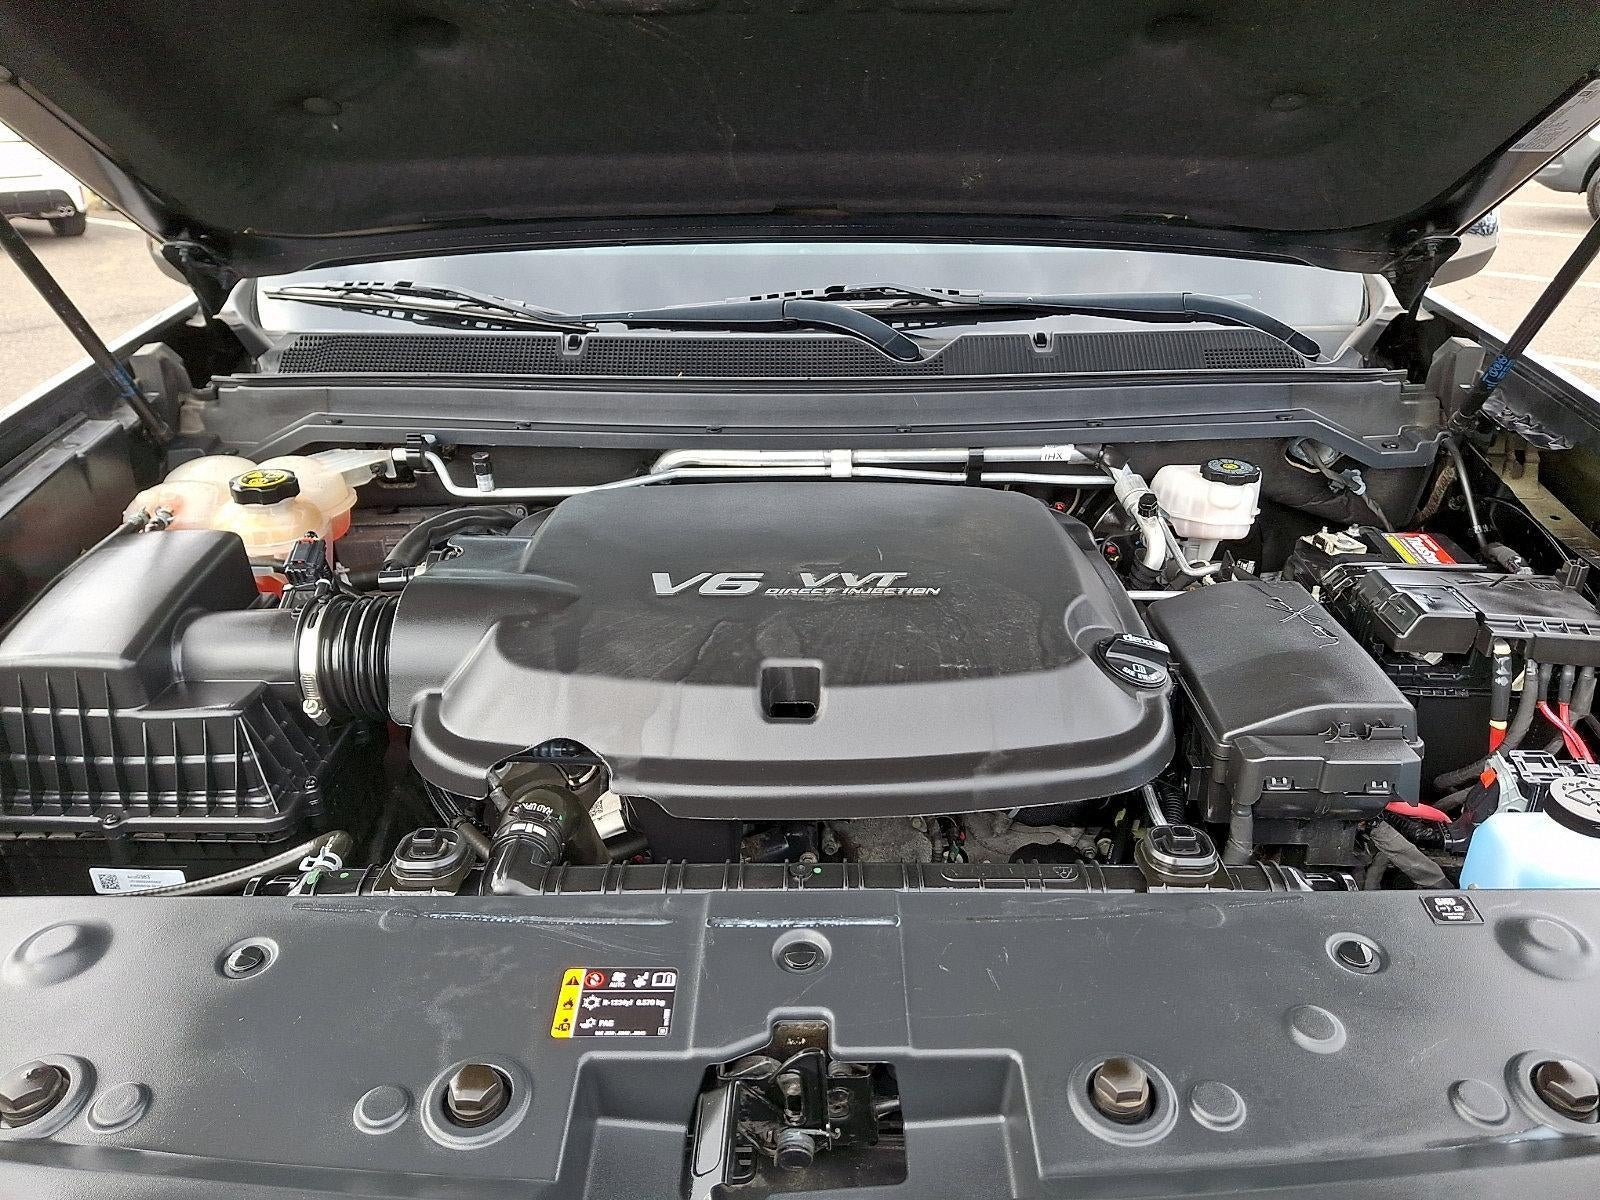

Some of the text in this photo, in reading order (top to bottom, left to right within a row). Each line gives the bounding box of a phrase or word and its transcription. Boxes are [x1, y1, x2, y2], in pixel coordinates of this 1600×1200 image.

[652, 572, 765, 596] V6
[800, 572, 908, 588] VVT
[764, 587, 941, 596] DIRECT INJECTION
